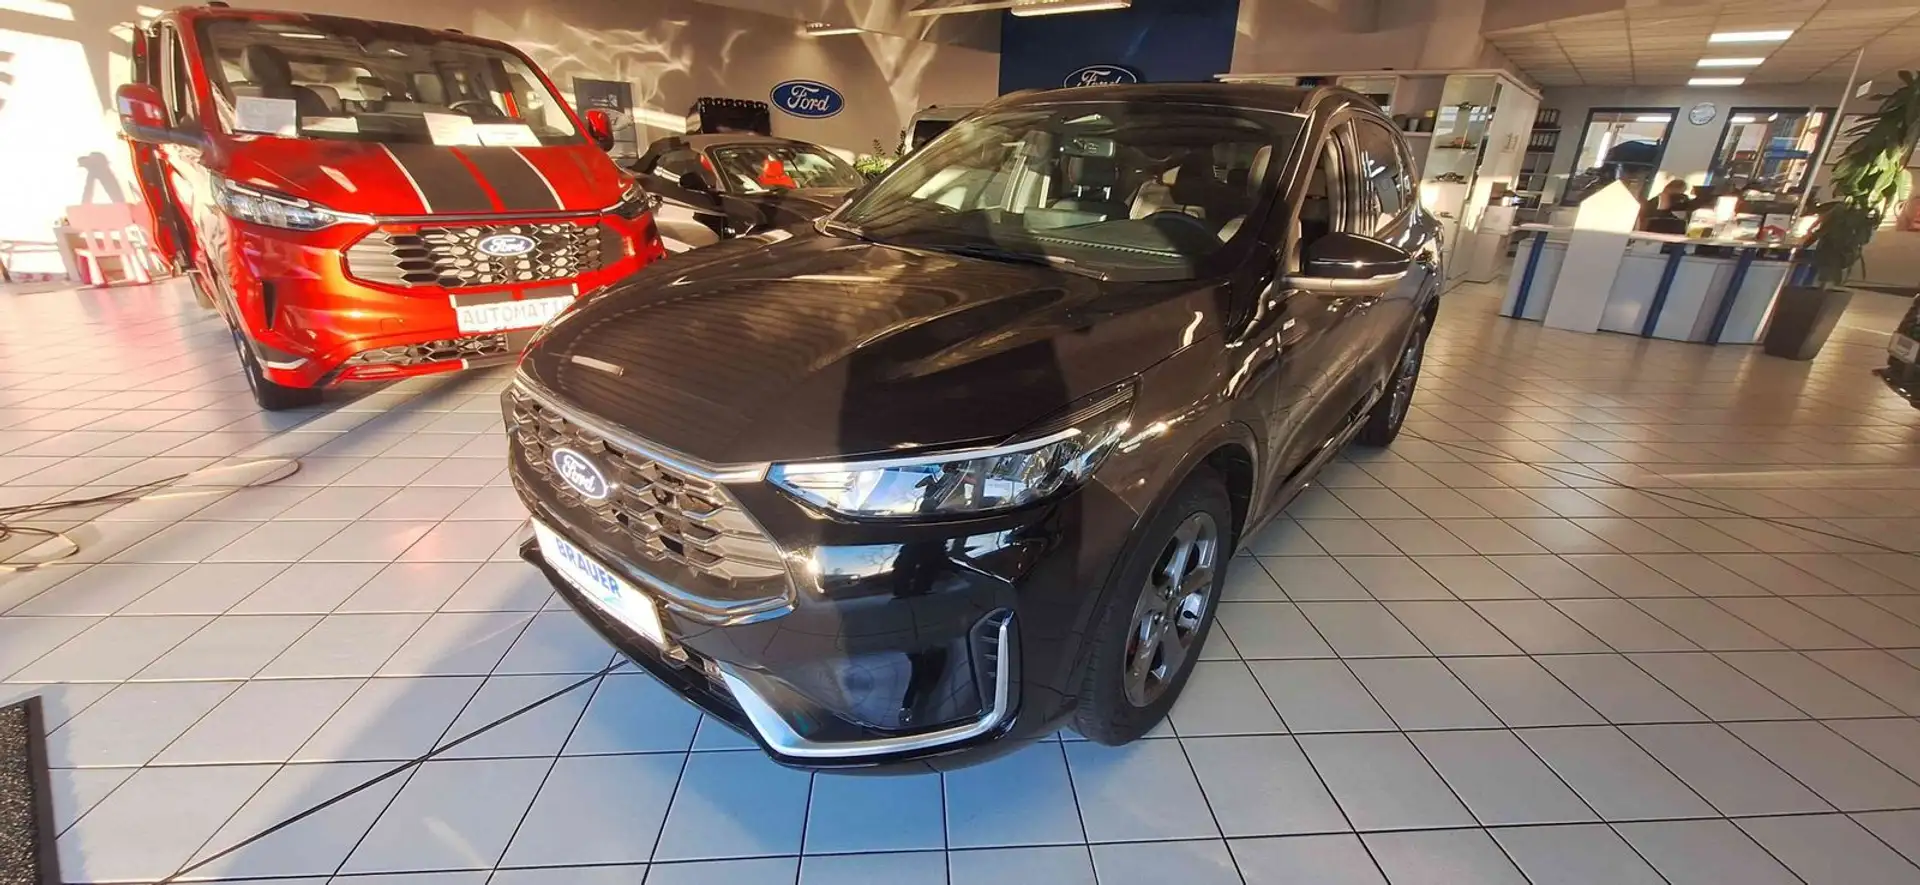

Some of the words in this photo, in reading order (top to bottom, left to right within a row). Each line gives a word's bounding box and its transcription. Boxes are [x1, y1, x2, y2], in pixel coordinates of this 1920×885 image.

[787, 85, 830, 111] Ford
[489, 238, 526, 253] Ford
[562, 454, 596, 493] Ford
[556, 537, 623, 598] BRAUER
